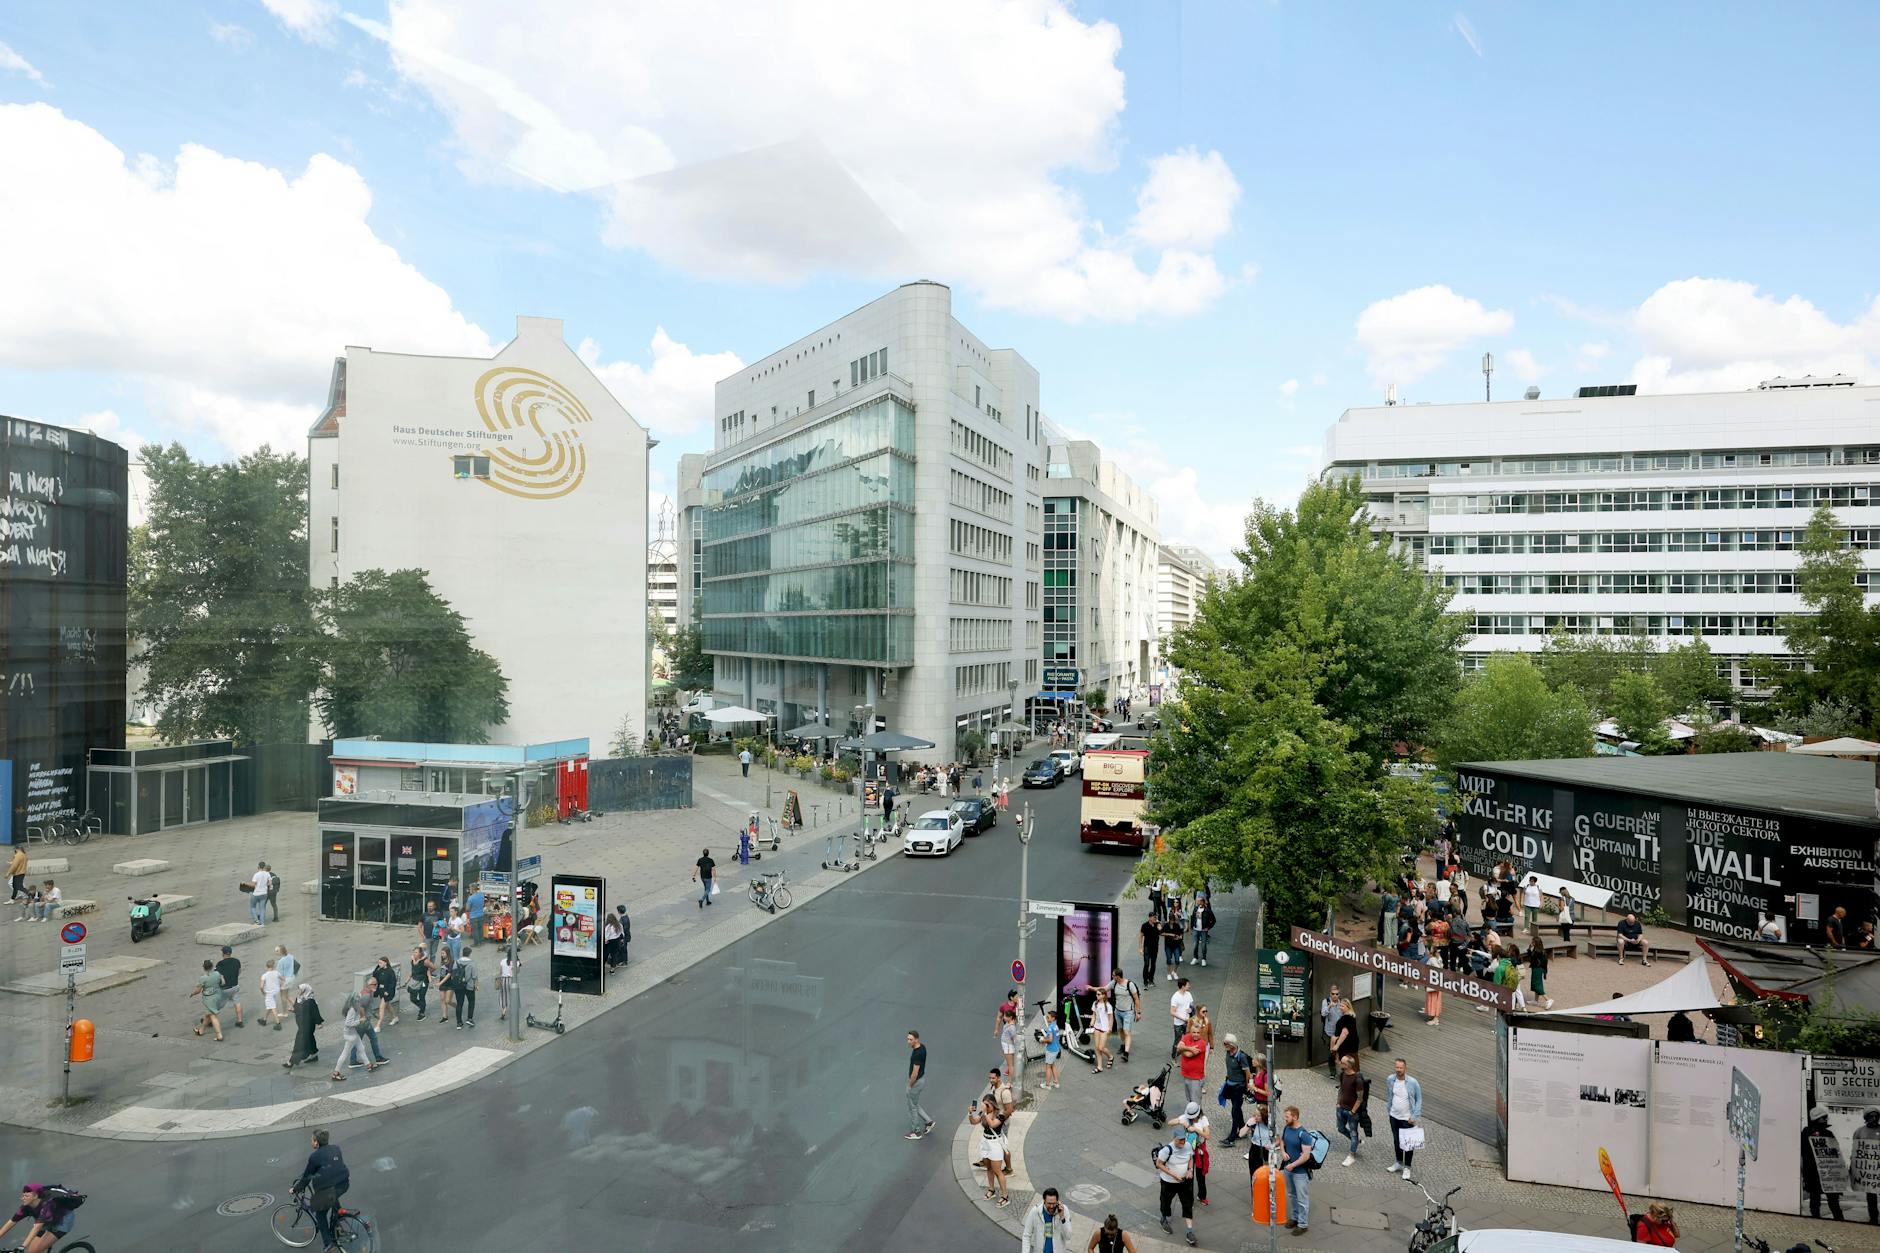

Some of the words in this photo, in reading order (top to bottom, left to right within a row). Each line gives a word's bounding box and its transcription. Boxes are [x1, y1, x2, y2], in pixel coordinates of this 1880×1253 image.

[393, 425, 416, 434] Haus
[418, 427, 464, 438] Deutscher
[466, 430, 513, 441] Stiftungen
[393, 437, 481, 451] www.Stiftungen.org
[1459, 774, 1496, 795] МИР
[1462, 794, 1527, 826] KALTER
[1593, 811, 1657, 837] GUERRE
[1732, 824, 1781, 842] СЕКТОРА
[1765, 819, 1780, 832] ИЗ
[1482, 828, 1538, 860] COLD
[1582, 836, 1637, 858] CURTAIN
[1790, 845, 1863, 859] EXHIBITION
[1473, 848, 1488, 858] ARE
[1520, 859, 1534, 869] THE
[1693, 844, 1782, 887] WALL
[1685, 870, 1744, 893] WEAPON
[1611, 891, 1652, 915] EACE
[1703, 886, 1768, 911] SPIONAGE
[1299, 932, 1369, 966] Checkpoint
[1372, 953, 1421, 981] Charlie
[1429, 969, 1500, 1004] BlackBox
[1823, 1076, 1836, 1086] DU
